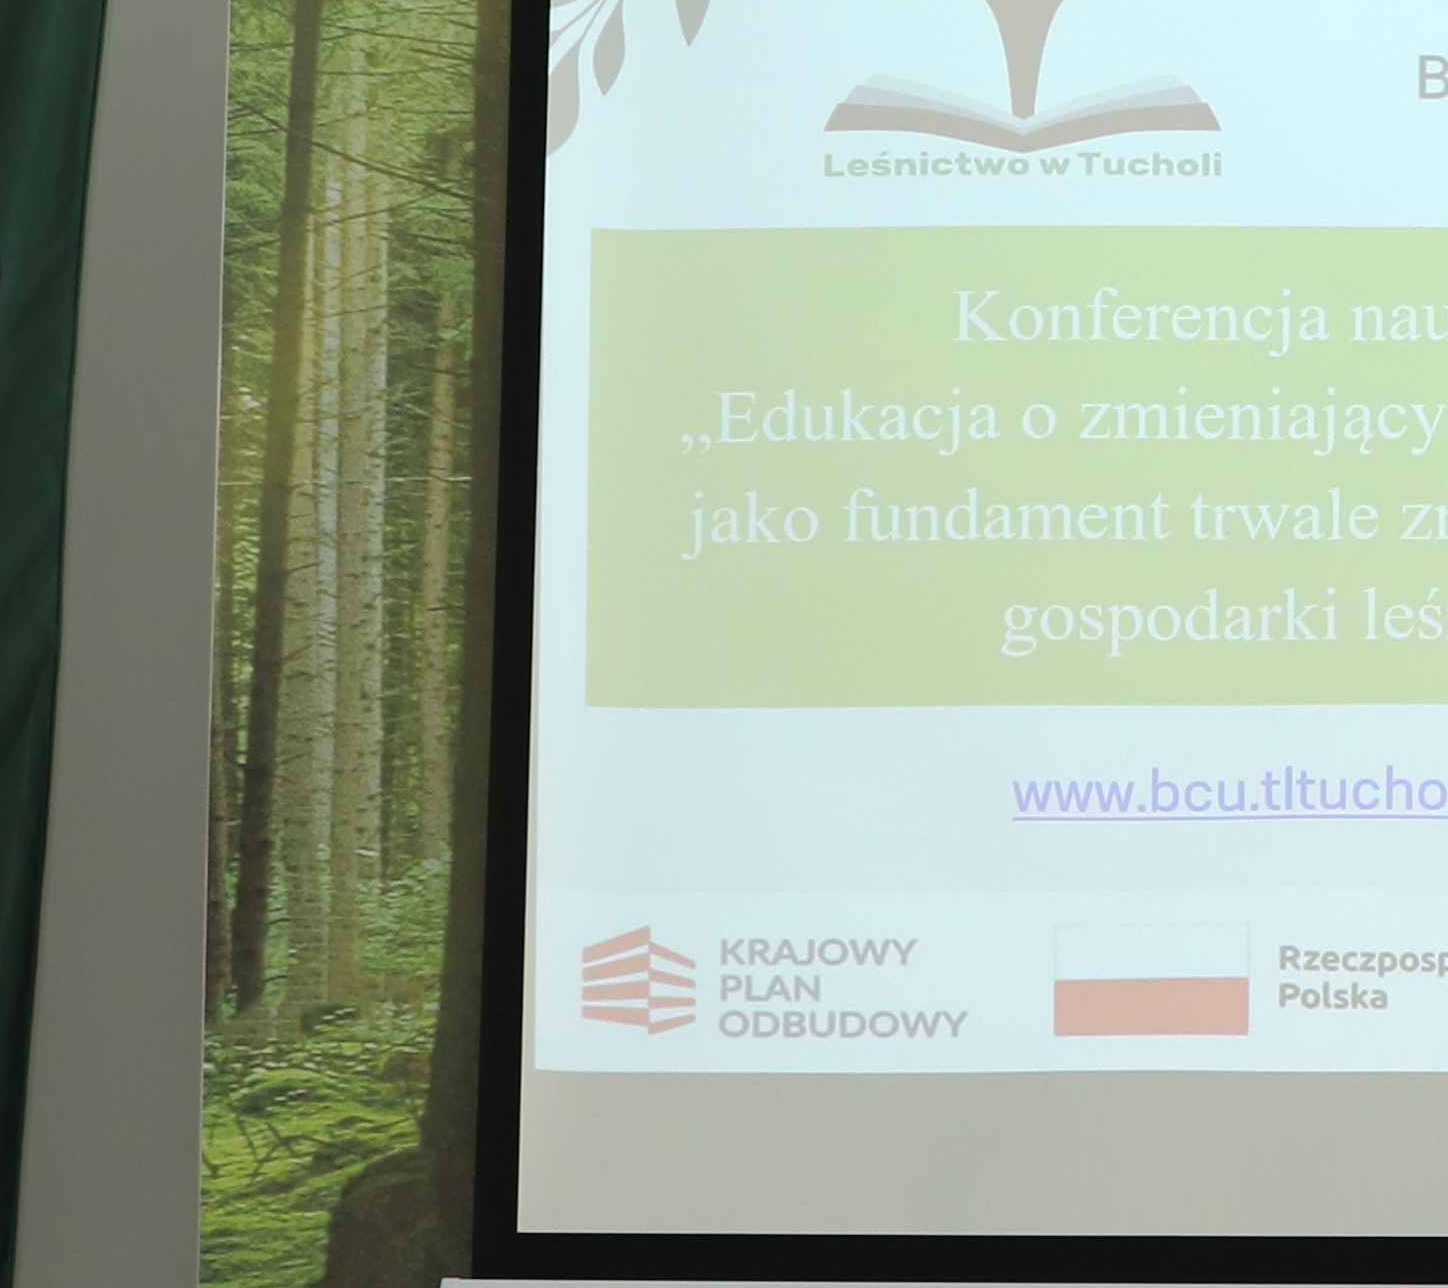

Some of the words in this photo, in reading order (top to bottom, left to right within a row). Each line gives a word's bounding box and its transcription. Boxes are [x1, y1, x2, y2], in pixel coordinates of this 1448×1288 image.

[823, 151, 1030, 177] Leśnictwo
[1041, 155, 1070, 175] w
[1077, 152, 1223, 177] Tucholi
[951, 286, 1331, 358] Konferencja
[680, 386, 1001, 456] „Edukacja
[1021, 402, 1057, 440] o
[680, 489, 819, 561] jako
[842, 487, 1170, 543] fundament
[1192, 487, 1380, 542] trwale
[999, 586, 1339, 659] gospodarki
[720, 938, 918, 966] KRAJOWY
[720, 974, 821, 1002] PLAN
[1278, 981, 1388, 1010] Polska
[718, 1010, 969, 1038] ODBUDOWY
